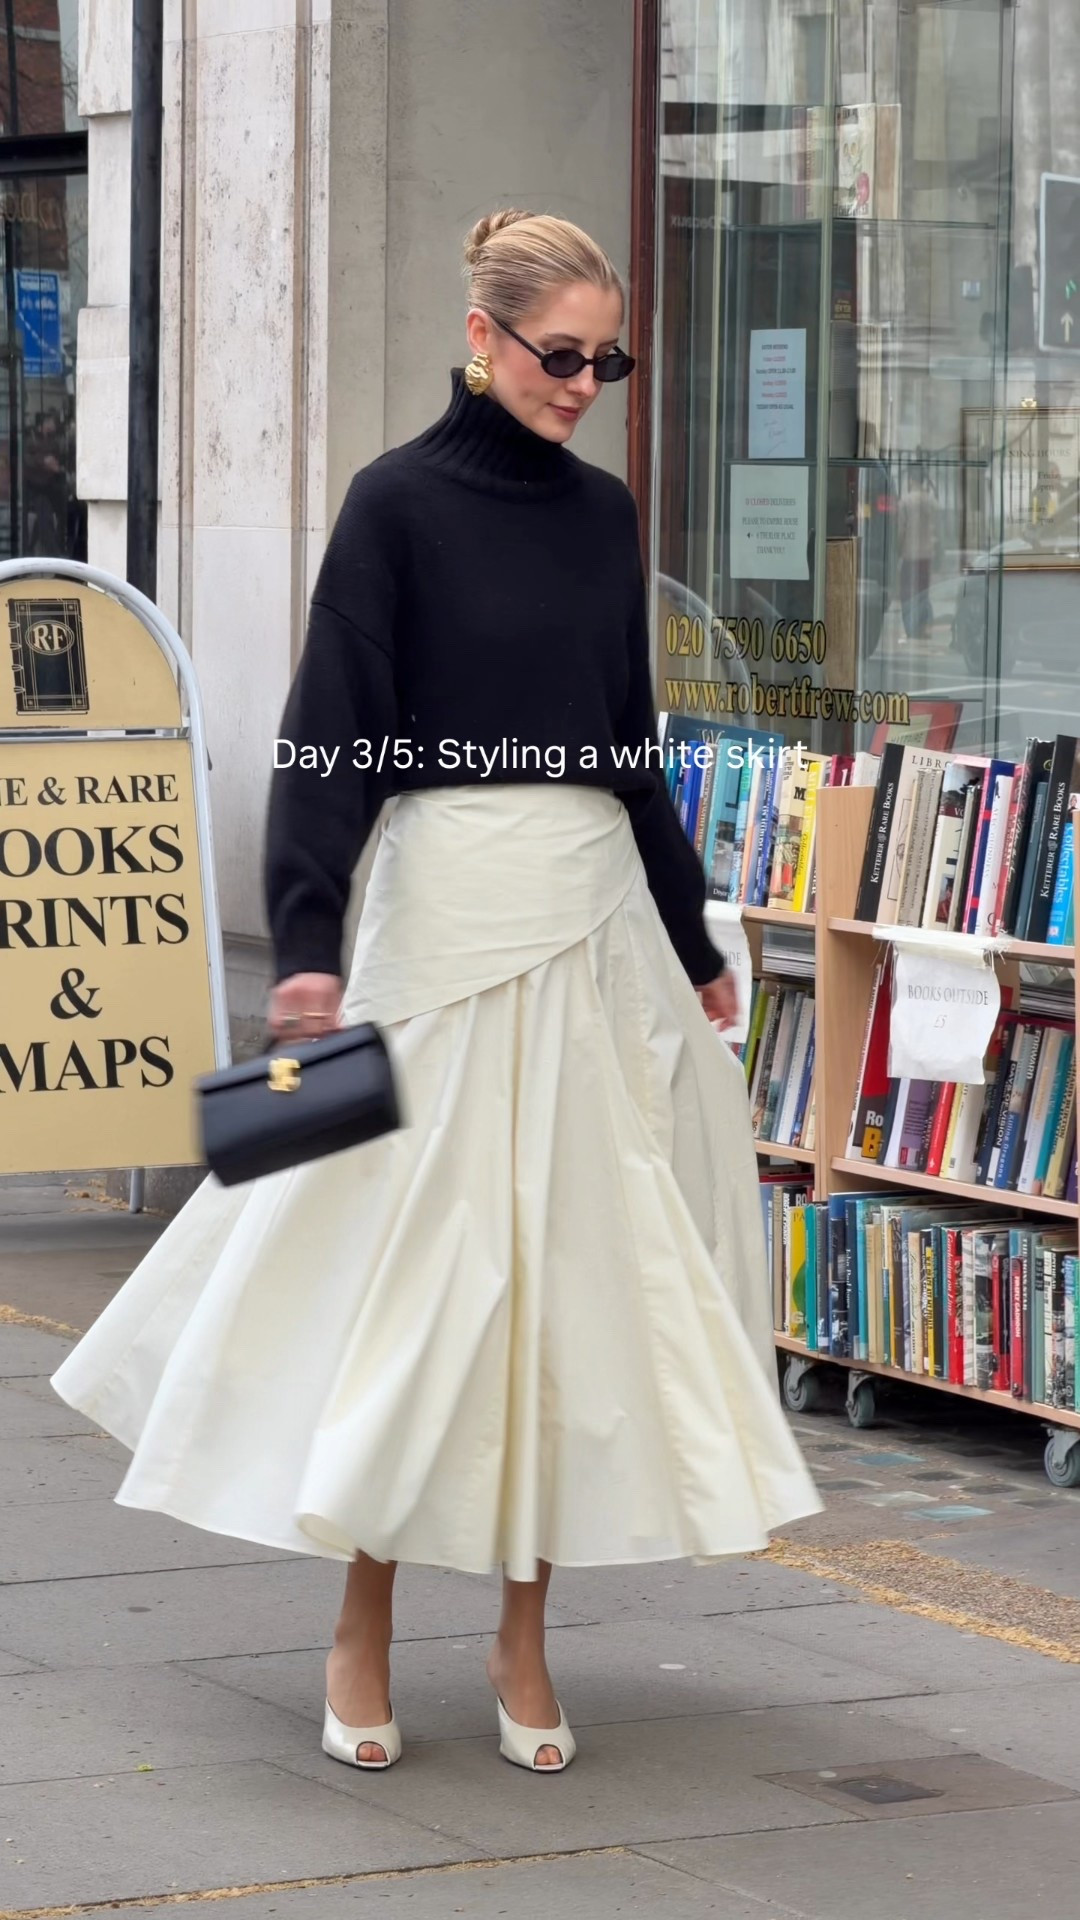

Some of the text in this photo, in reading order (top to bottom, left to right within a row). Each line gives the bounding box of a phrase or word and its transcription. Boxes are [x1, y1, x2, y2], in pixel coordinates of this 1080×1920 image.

[665, 614, 826, 664] 020 7590 6650
[664, 672, 910, 726] www.robertfrew.com
[37, 777, 67, 805] &
[76, 774, 179, 804] RARE
[0, 823, 184, 878] OOKS
[868, 781, 895, 883] KETTERER RARE BOOKS
[1038, 781, 1067, 898] KETTERER RARE BOOKS
[1054, 824, 1078, 904] Collectables
[50, 967, 103, 1020] &
[908, 984, 988, 1006] BOOKS OUTSIDE
[934, 1014, 948, 1028] £5
[0, 1036, 174, 1093] MAPS
[1005, 1062, 1017, 1090] DAYS
[1025, 1029, 1041, 1080] FORWARD
[866, 1111, 884, 1127] Ro
[1003, 1092, 1011, 1105] OF
[995, 1109, 1008, 1145] VISION
[1003, 1113, 1015, 1141] Killing
[996, 1142, 1009, 1178] Dragons
[946, 1233, 954, 1278] Gardening
